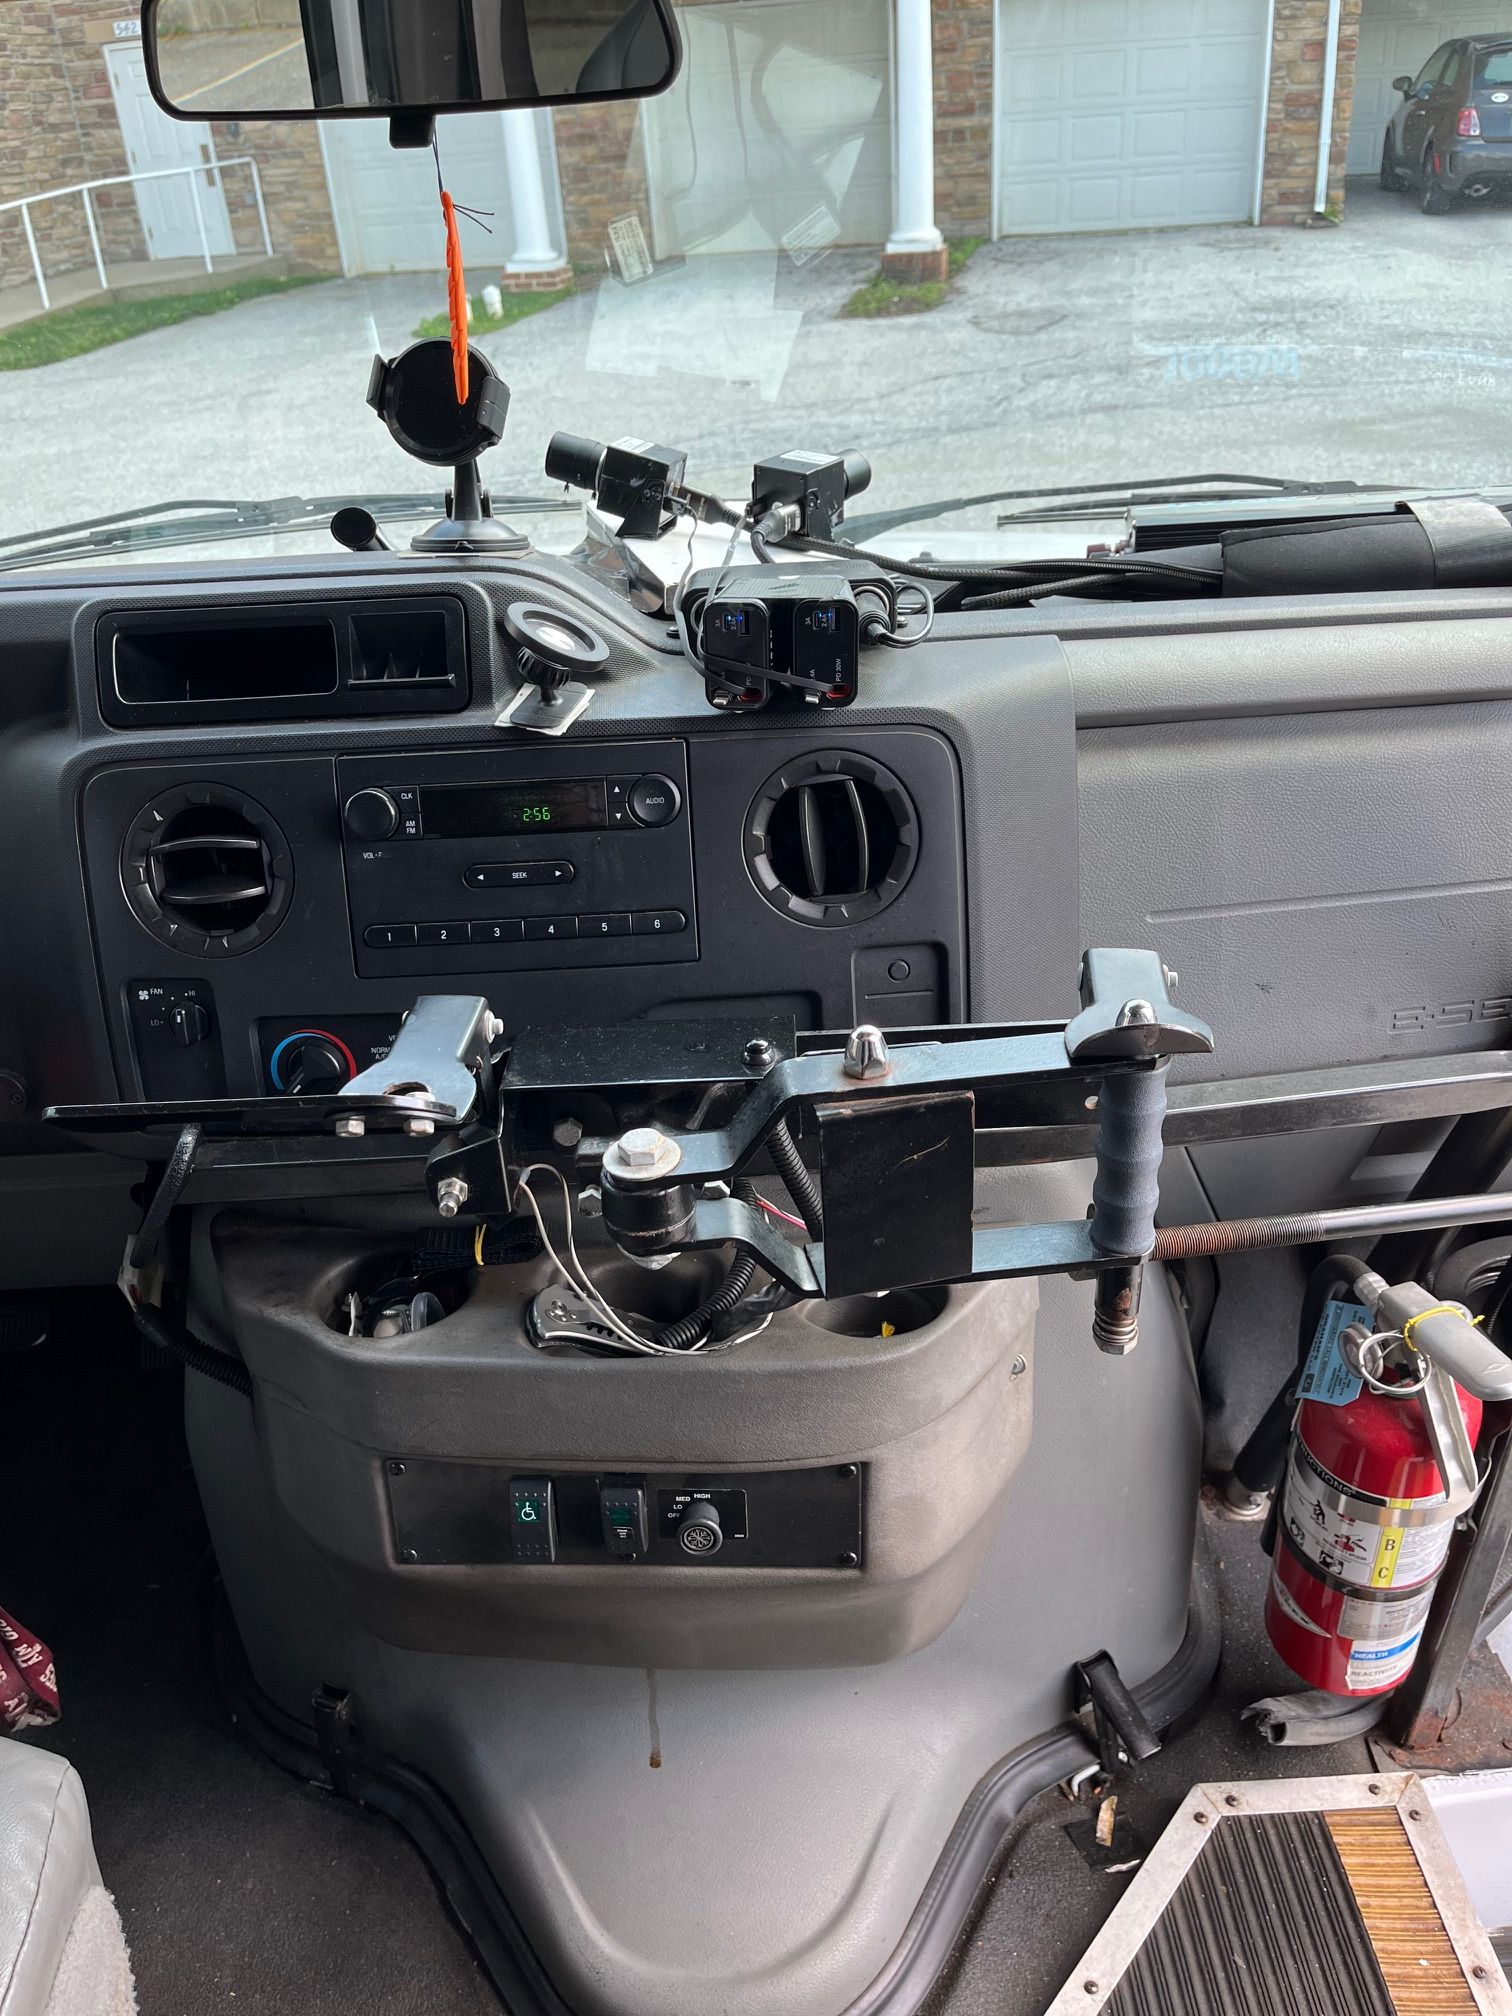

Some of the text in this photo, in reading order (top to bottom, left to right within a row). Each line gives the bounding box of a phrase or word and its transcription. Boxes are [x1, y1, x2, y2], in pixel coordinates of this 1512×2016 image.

[401, 792, 413, 800] CLK
[645, 797, 665, 805] AUDIO
[522, 806, 551, 822] 2:56
[601, 922, 608, 932] 5
[654, 919, 661, 928] 6
[493, 927, 501, 937] 3
[548, 925, 555, 934] 4
[441, 930, 447, 940] 2
[150, 1019, 160, 1027] LO
[1384, 1538, 1396, 1551] B
[1378, 1566, 1389, 1579] C
